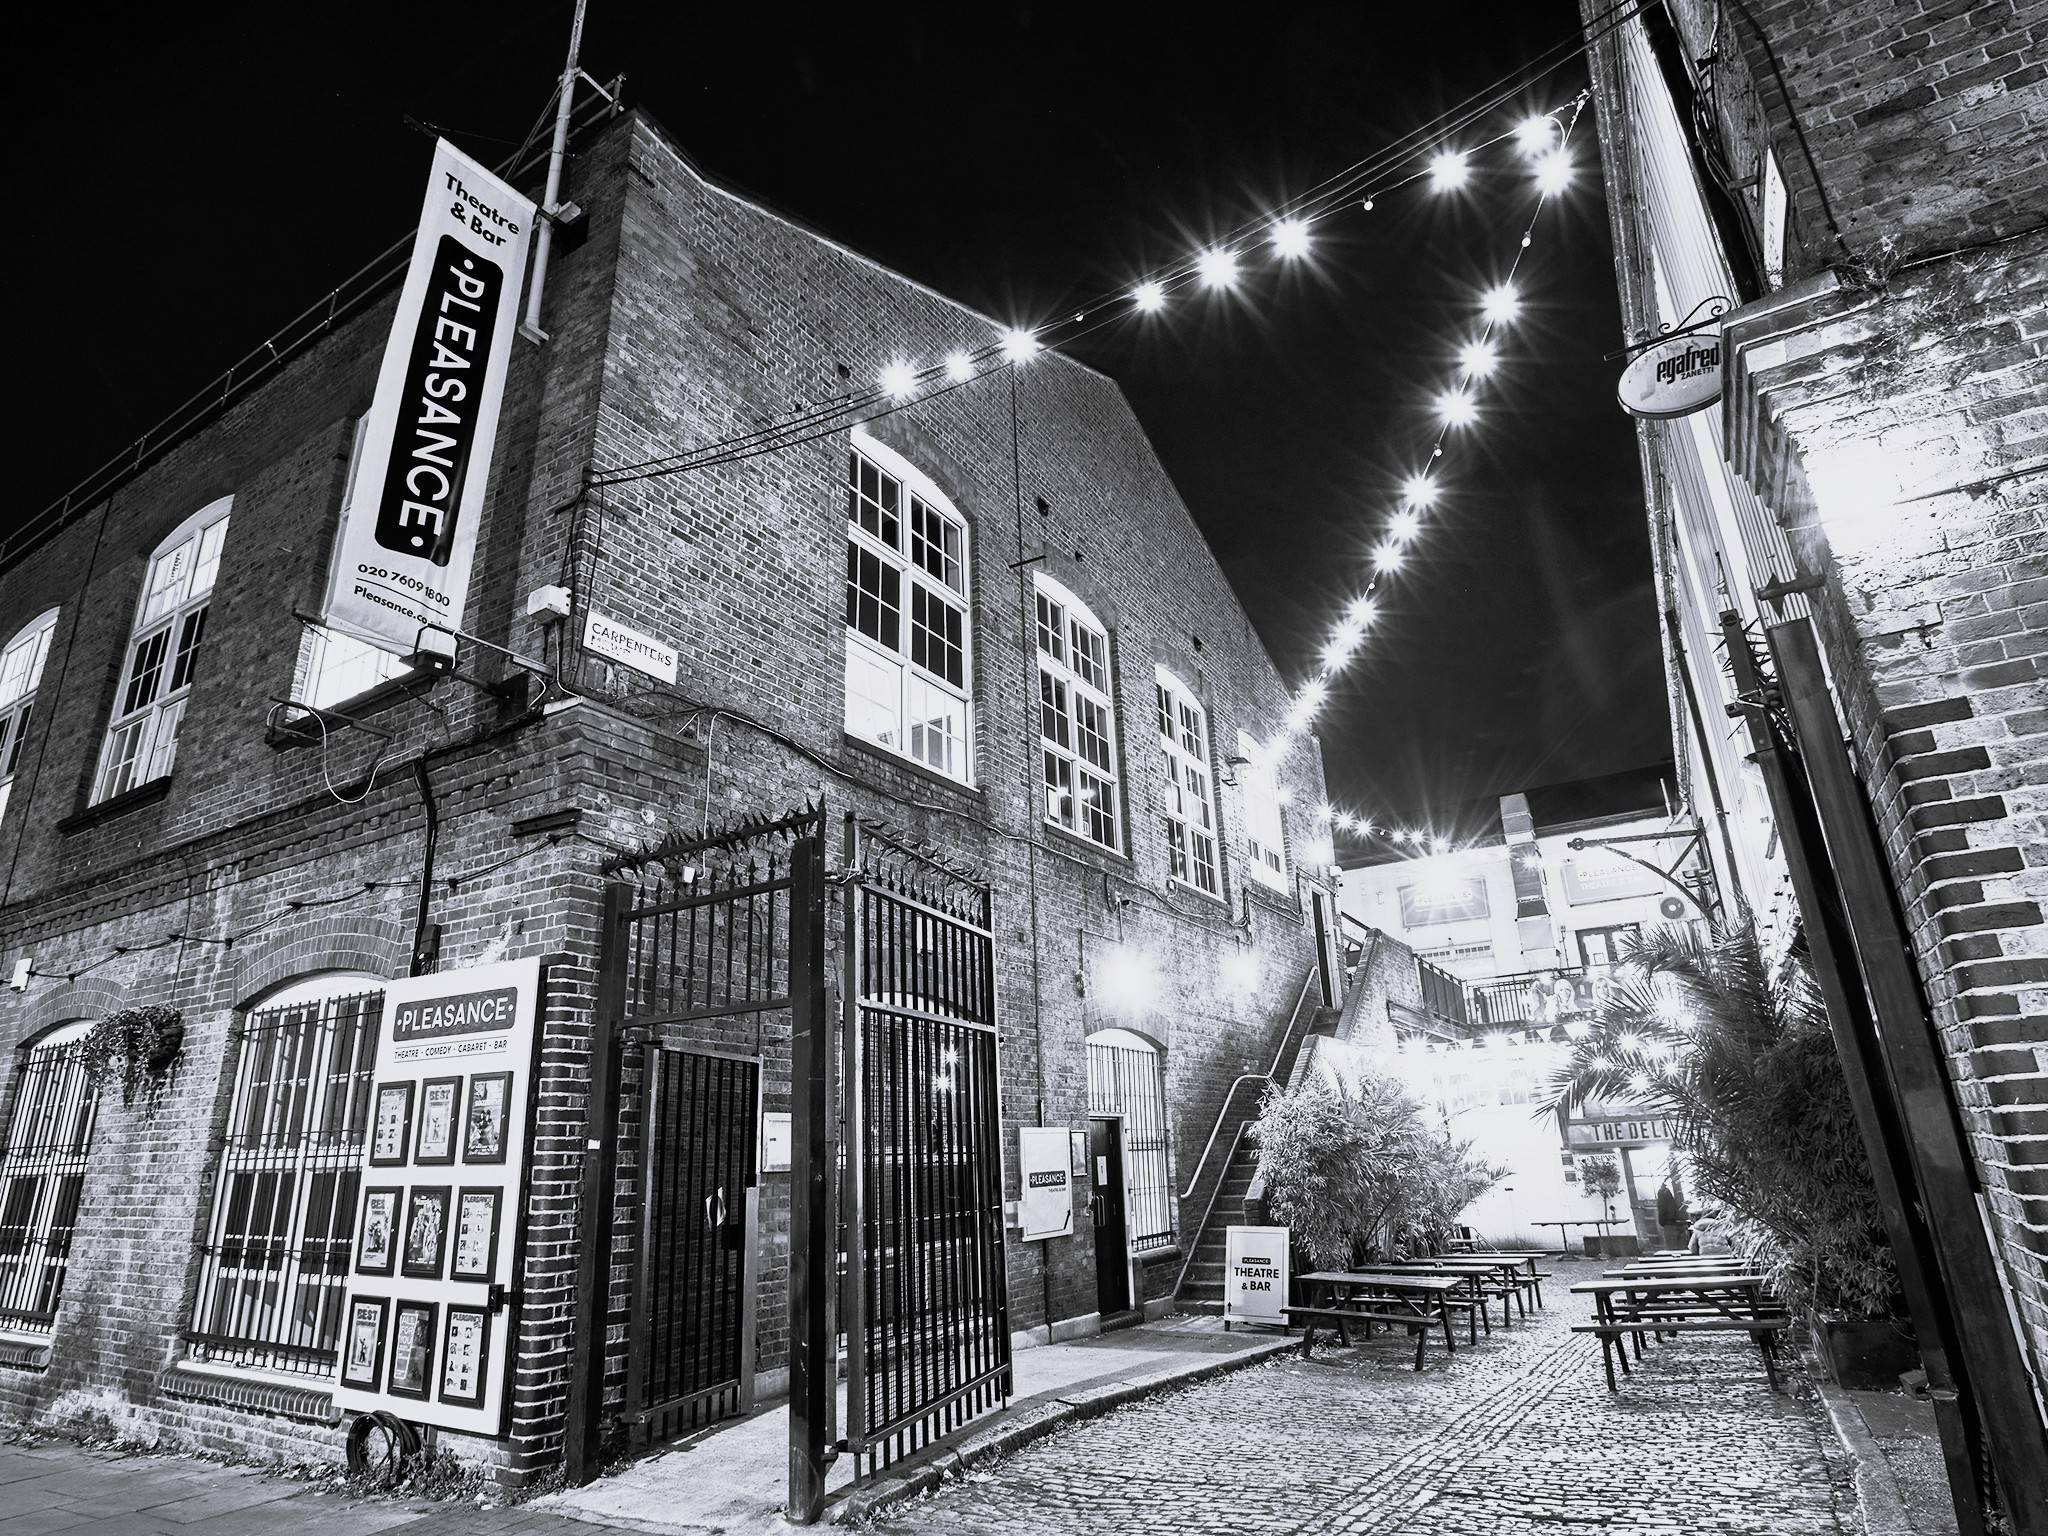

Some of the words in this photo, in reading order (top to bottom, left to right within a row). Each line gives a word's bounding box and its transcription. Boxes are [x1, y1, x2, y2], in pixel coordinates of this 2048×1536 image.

[443, 171, 521, 236] Theatre
[449, 201, 468, 225] &
[469, 213, 507, 249] Bar
[1647, 341, 1720, 392] egafred
[1680, 366, 1714, 380] ZANETTI
[397, 264, 485, 537] PLEASANCE
[357, 563, 388, 578] 020
[390, 571, 424, 592] 7609
[424, 586, 450, 607] 1800
[353, 584, 432, 625] Pleasance.co
[591, 622, 672, 667] CARPENTERS
[401, 996, 509, 1033] PLEASANCE
[394, 1049, 420, 1060] THEATRE
[425, 1045, 451, 1057] COMEDY
[458, 1041, 487, 1054] CABARET
[494, 1039, 508, 1050] BAR
[1592, 1123, 1624, 1142] THE
[1628, 1120, 1669, 1140] DELI
[1031, 1173, 1064, 1185] PLEASANCE
[1234, 1267, 1280, 1278] THEATRE
[1241, 1282, 1248, 1290] &
[1250, 1281, 1271, 1291] BAR
[357, 1308, 378, 1321] BEST
